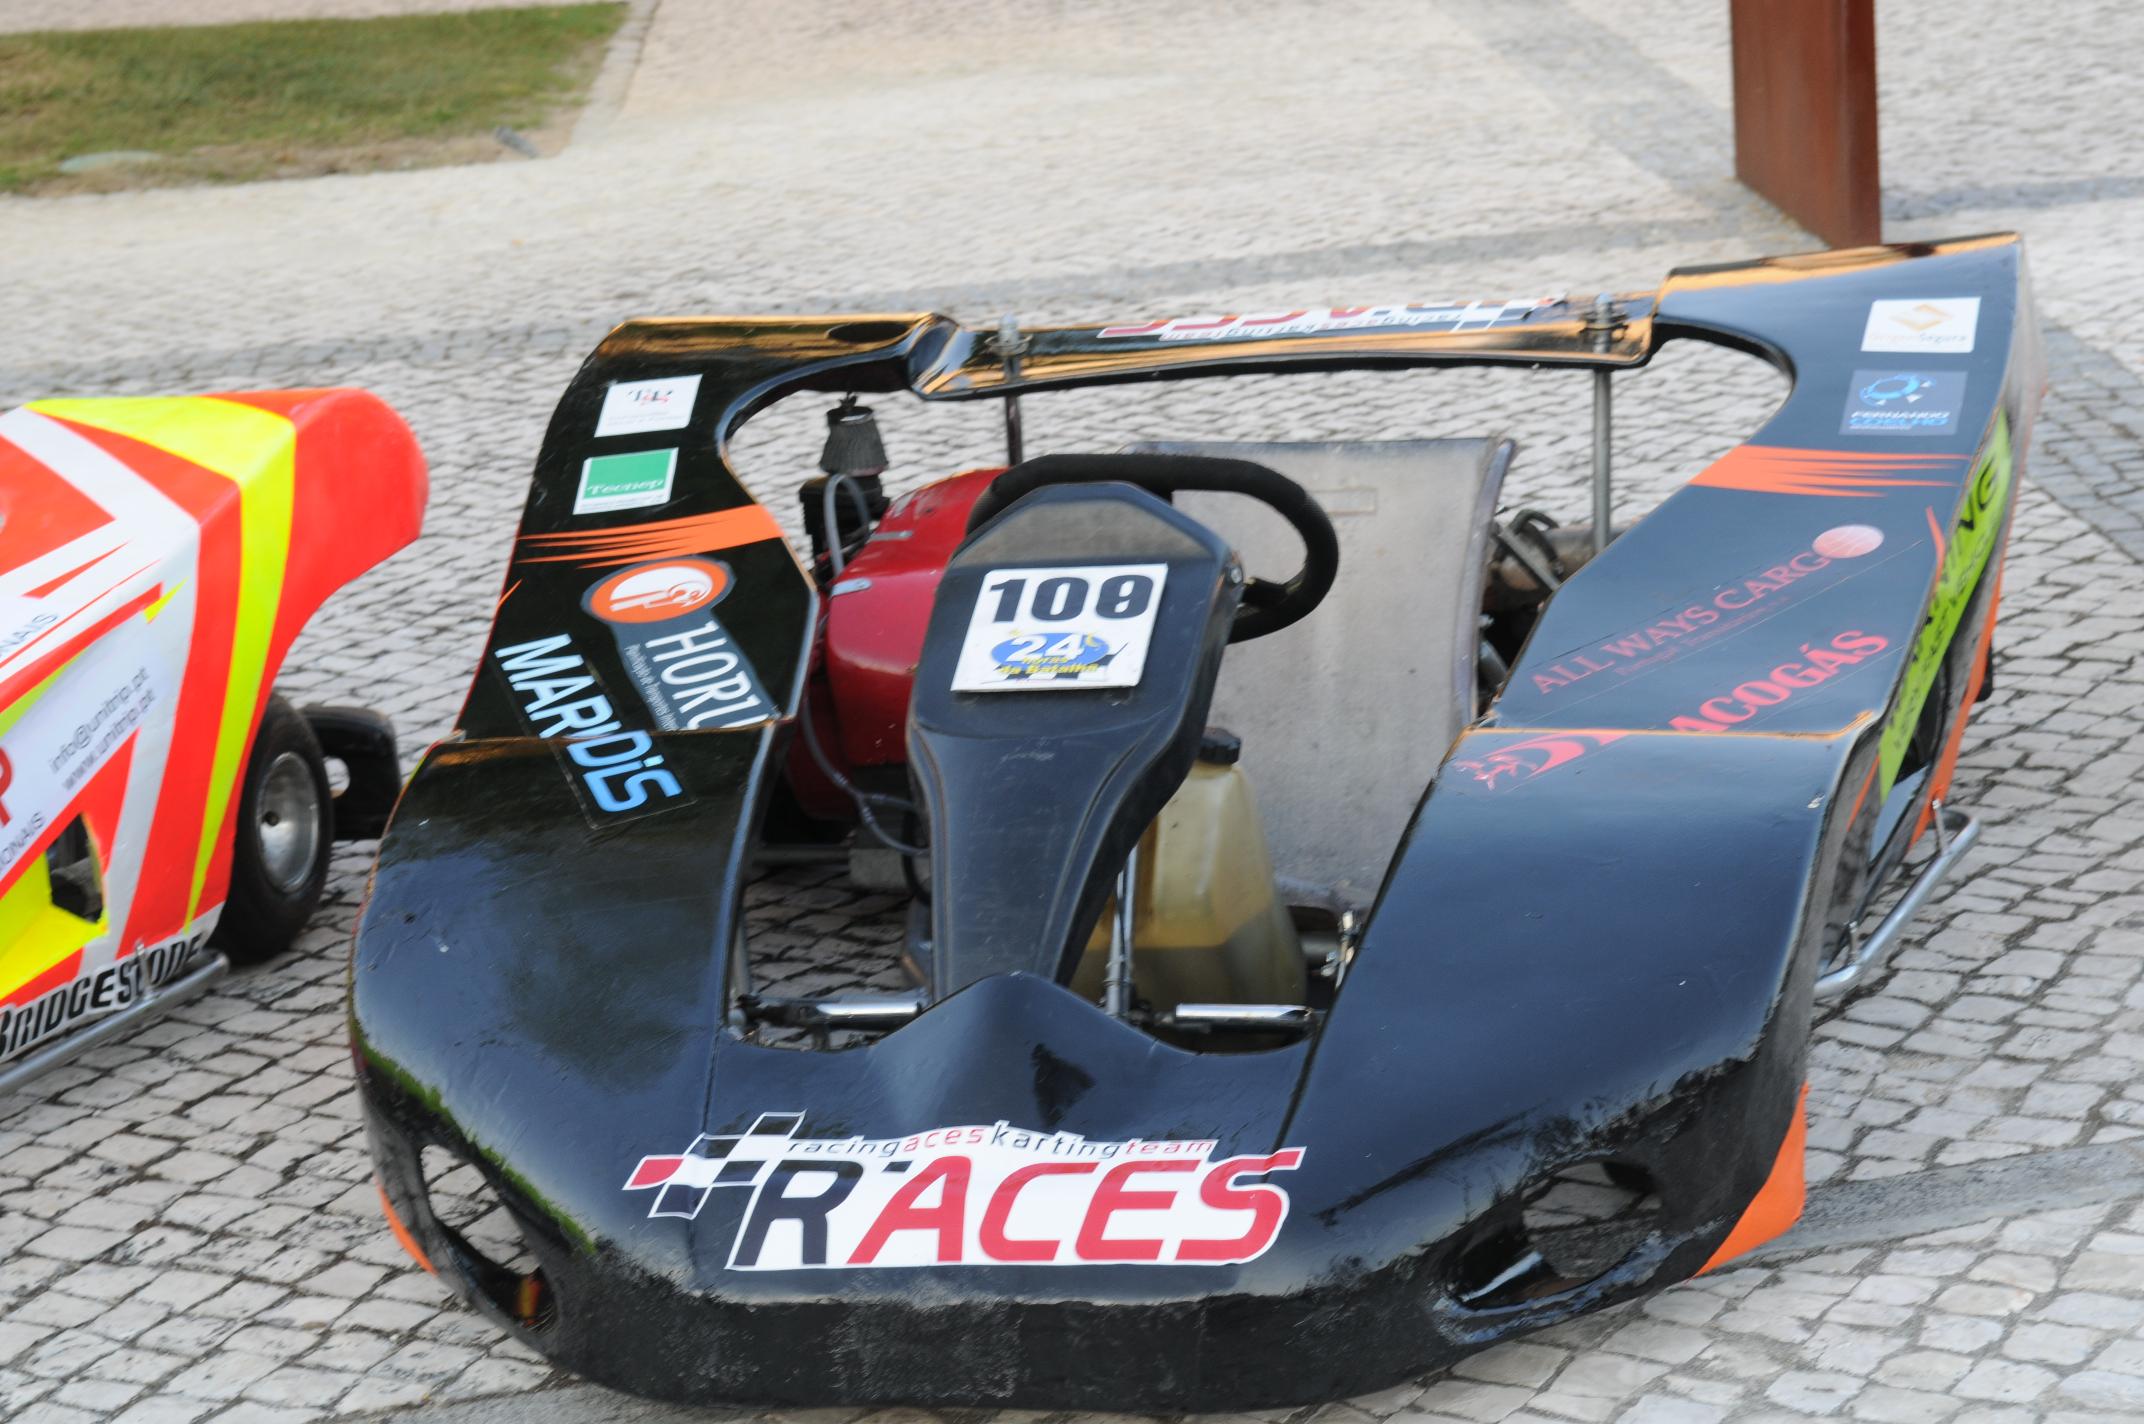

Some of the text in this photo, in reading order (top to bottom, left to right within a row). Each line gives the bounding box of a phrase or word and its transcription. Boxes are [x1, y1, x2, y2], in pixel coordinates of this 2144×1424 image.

[1005, 633, 1085, 662] 24
[1532, 655, 1616, 695] ALL
[1604, 607, 1720, 660] WAYS
[734, 1150, 1301, 1267] RACES
